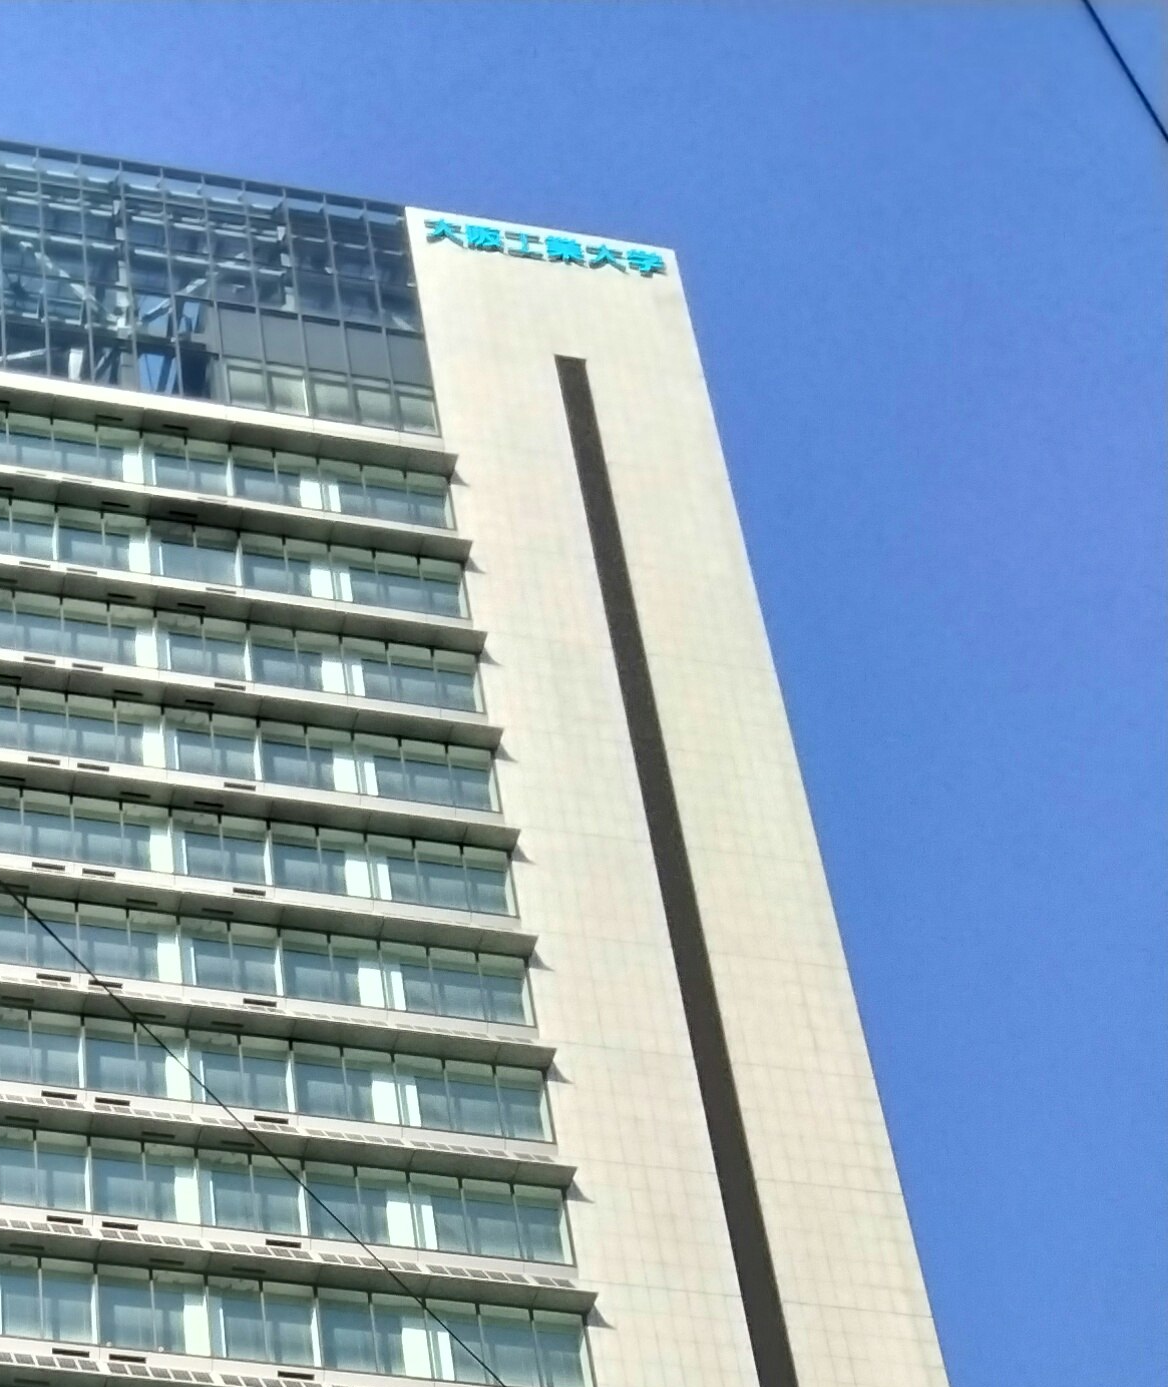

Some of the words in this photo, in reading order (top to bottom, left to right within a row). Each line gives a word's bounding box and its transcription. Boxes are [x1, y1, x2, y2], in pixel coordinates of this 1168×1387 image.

[424, 218, 667, 277] 大阪工業大学
